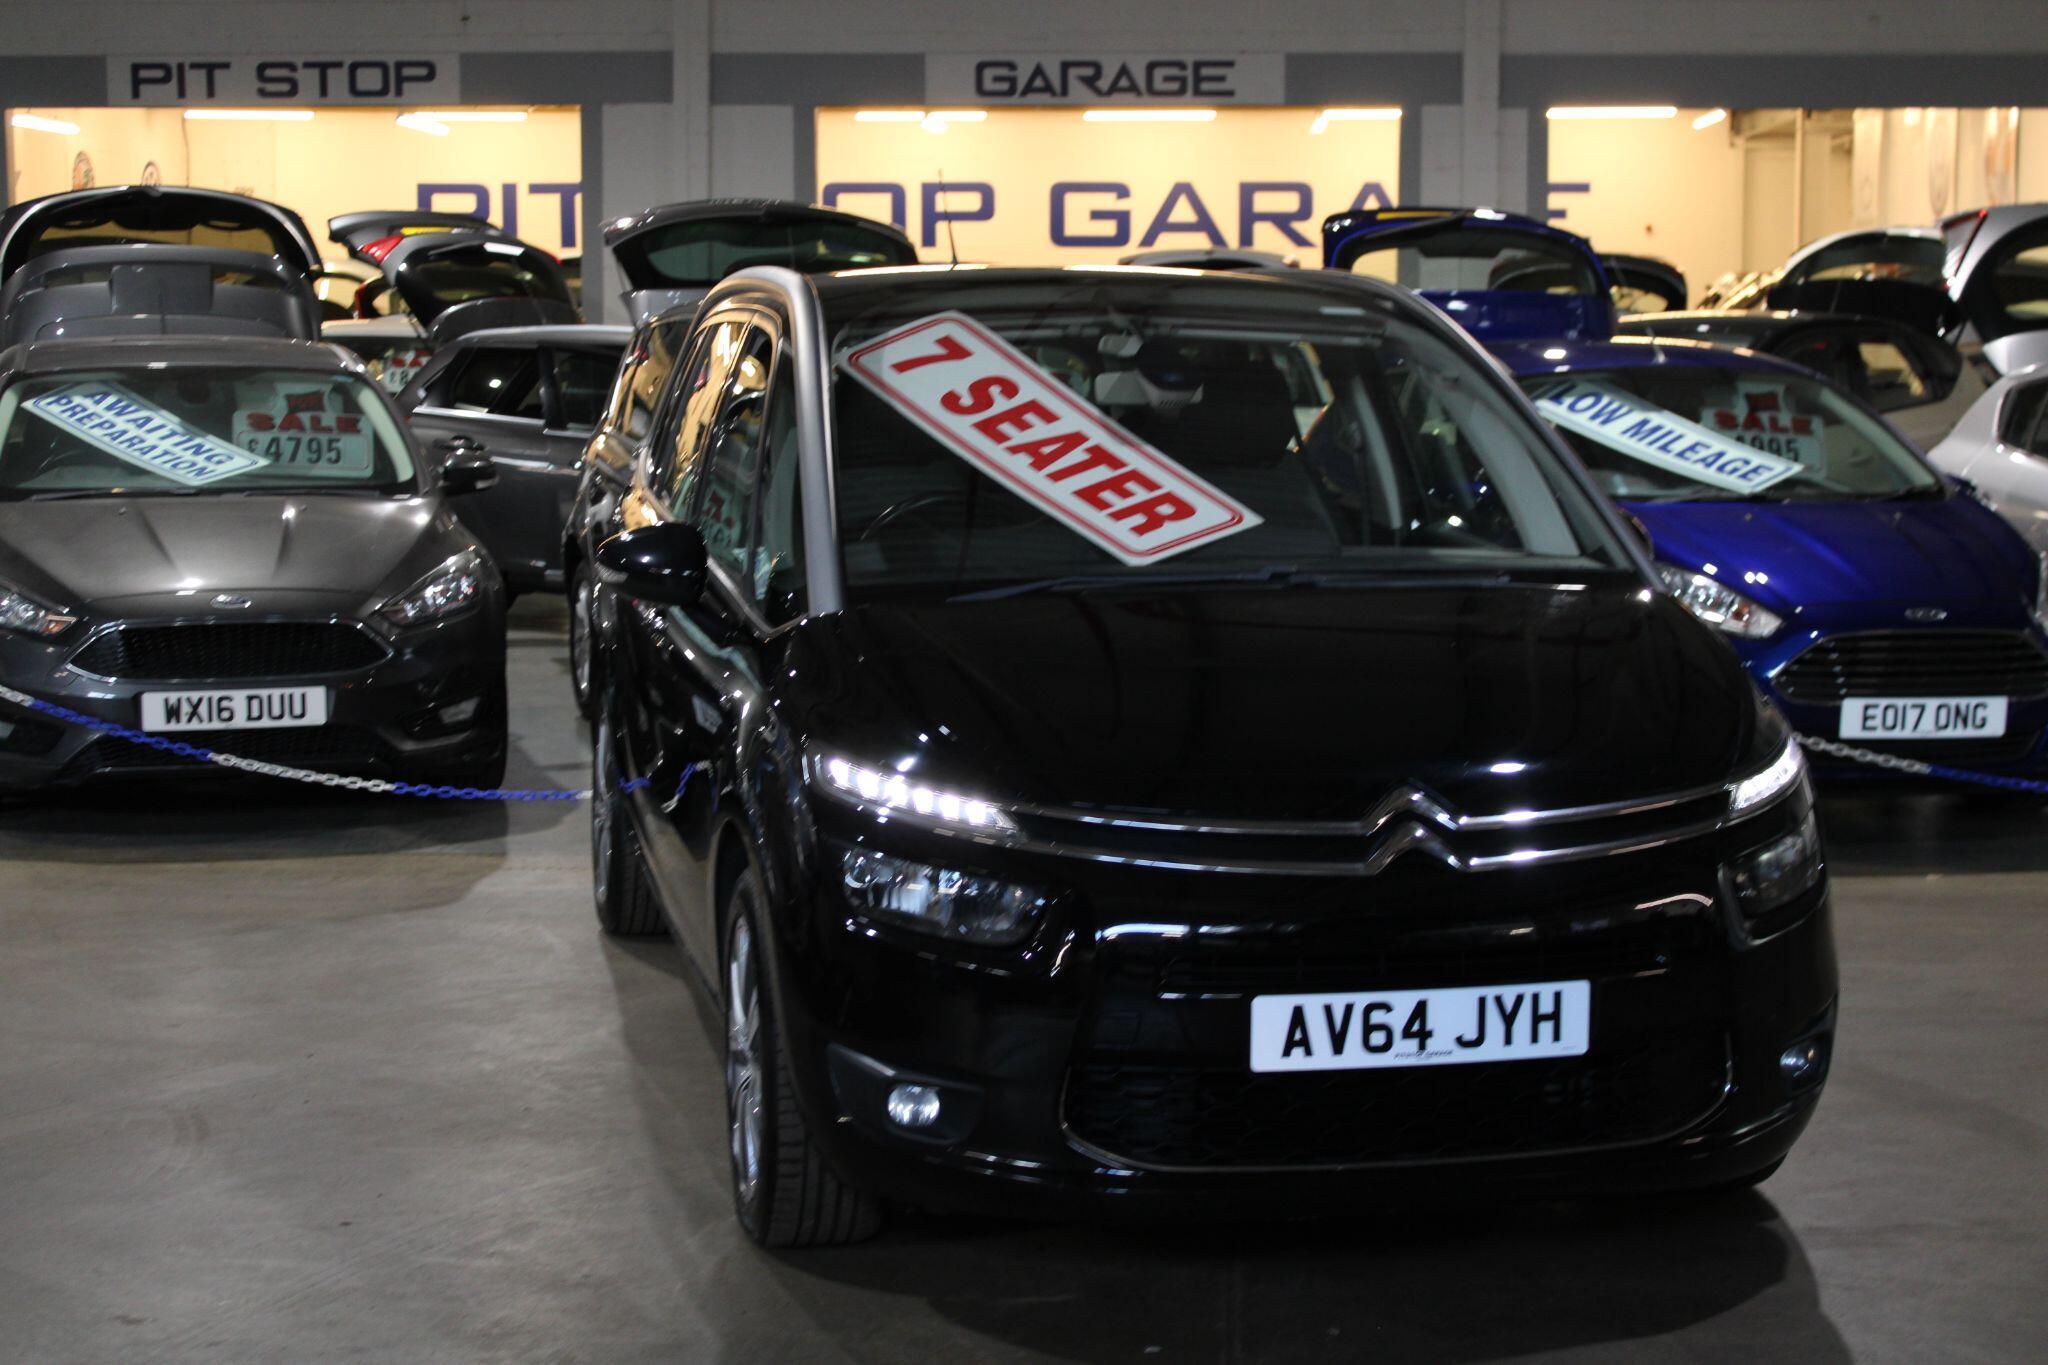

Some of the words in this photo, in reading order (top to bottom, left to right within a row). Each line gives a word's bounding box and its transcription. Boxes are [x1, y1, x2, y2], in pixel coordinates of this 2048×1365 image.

[129, 61, 232, 100] PIT
[255, 60, 437, 99] STOP
[974, 59, 1235, 98] GARAGE
[46, 393, 218, 479] PREPARATION
[84, 389, 236, 466] AWAITING
[247, 437, 342, 465] £4795
[891, 336, 974, 373] 7
[940, 376, 1197, 537] SEATER
[1550, 383, 1634, 427] LOW
[1620, 412, 1778, 483] MILEAGE
[164, 696, 235, 725] WX16
[246, 692, 306, 722] DUU
[1934, 702, 1988, 732] ONG
[1281, 999, 1434, 1058] AV64
[1455, 990, 1563, 1048] JYH
